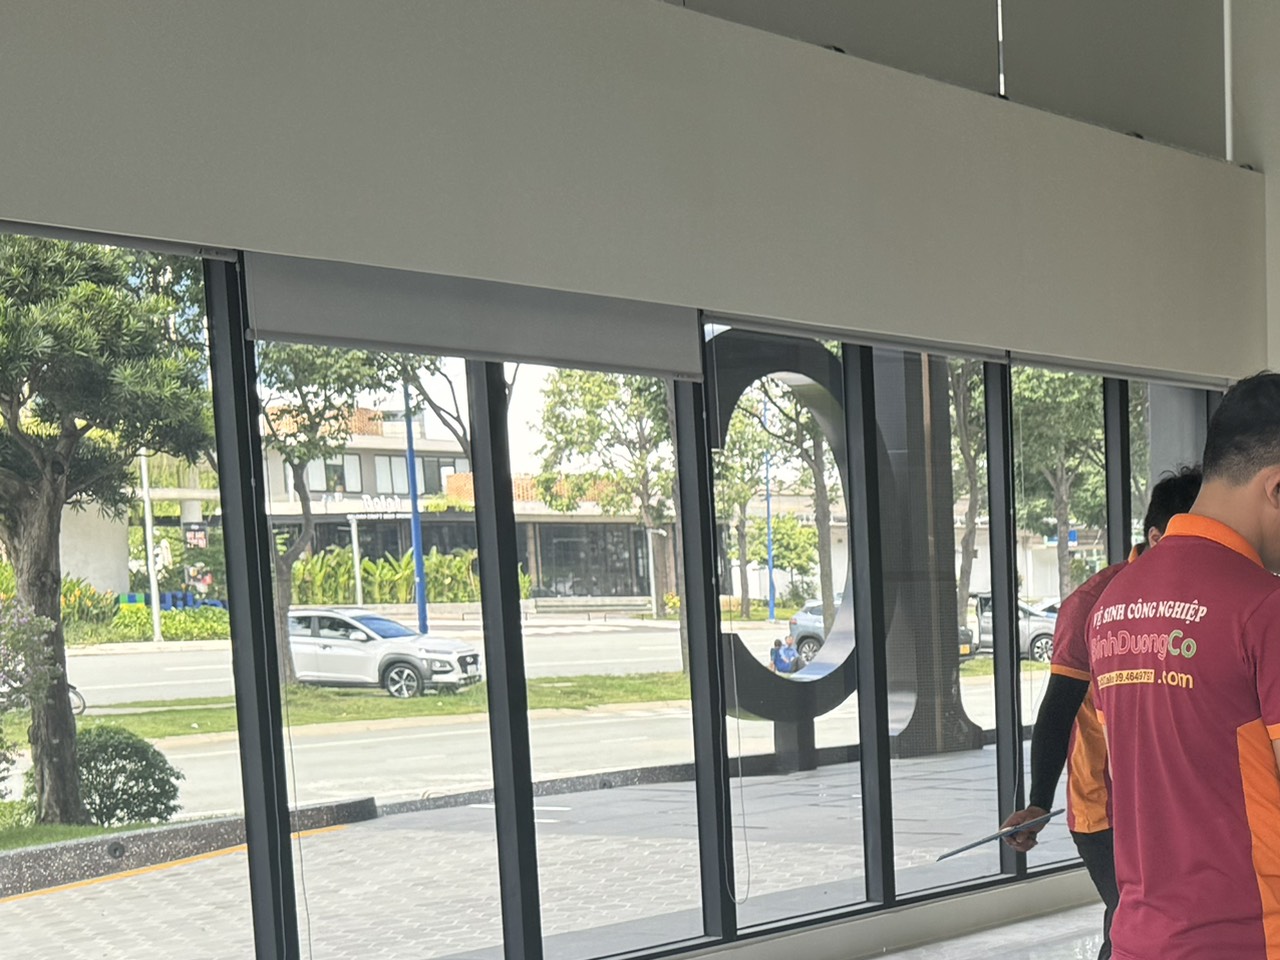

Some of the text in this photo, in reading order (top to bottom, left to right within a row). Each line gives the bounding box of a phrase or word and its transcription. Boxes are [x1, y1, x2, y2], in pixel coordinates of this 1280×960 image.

[1103, 604, 1126, 624] SINH
[1127, 598, 1157, 619] CÔNG
[1157, 599, 1207, 624] NGHIỆP
